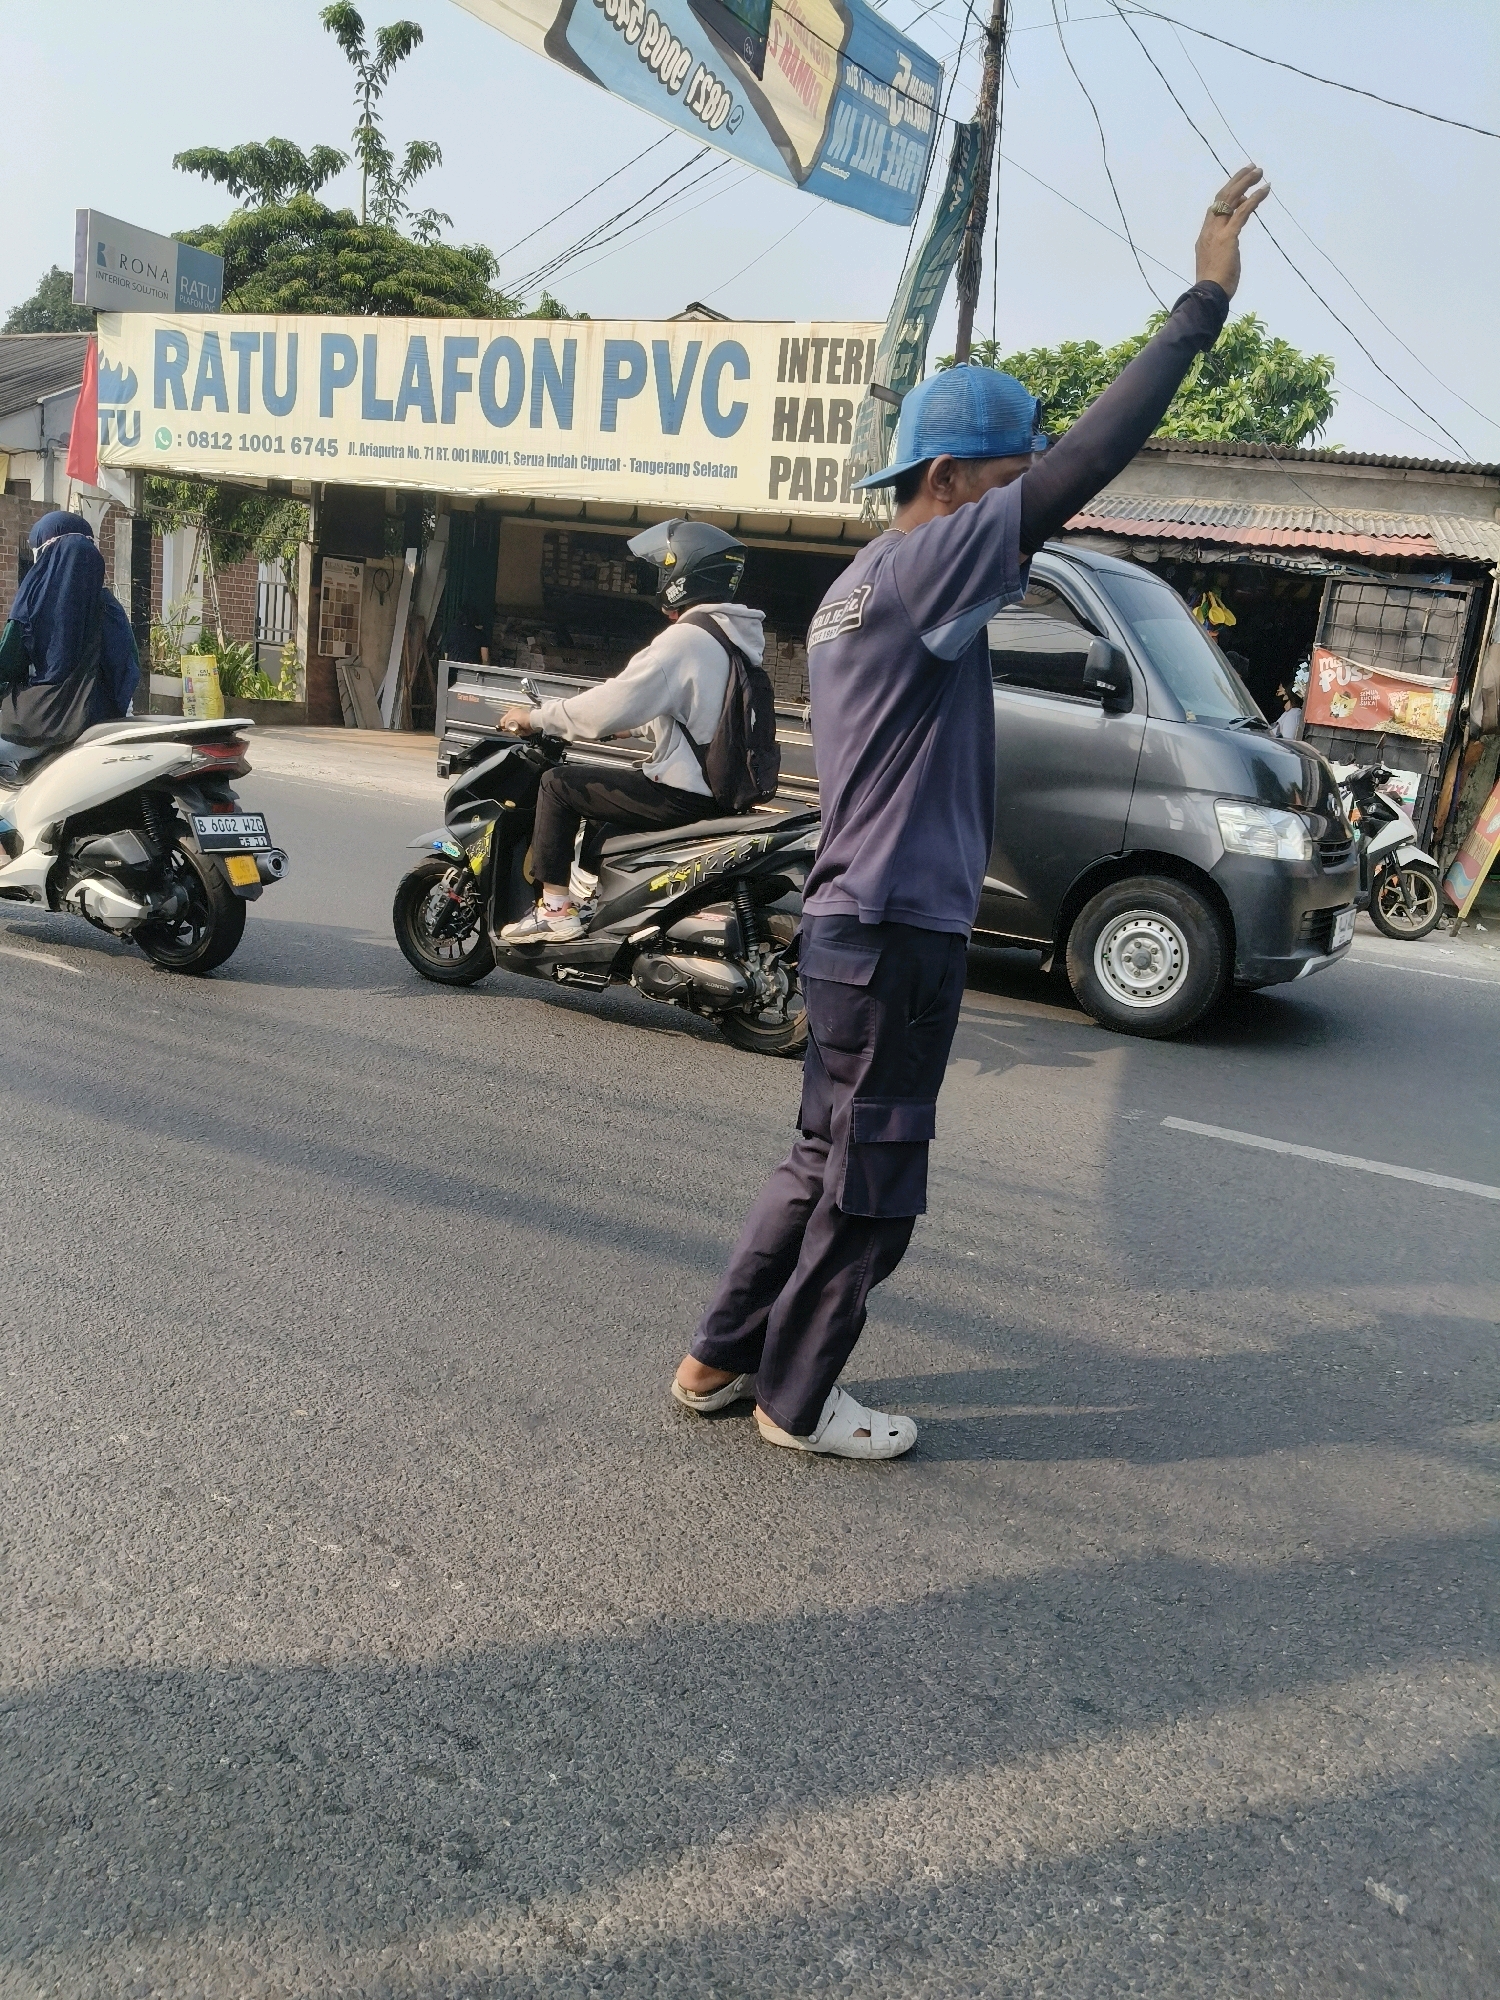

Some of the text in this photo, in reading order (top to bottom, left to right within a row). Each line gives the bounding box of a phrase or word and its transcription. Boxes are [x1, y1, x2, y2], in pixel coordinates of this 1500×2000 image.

[119, 253, 170, 284] RONA
[96, 271, 169, 301] INTERIOR SOLUTION
[180, 276, 217, 304] RATU
[179, 294, 216, 313] PLAFON PVC
[153, 329, 299, 417] RATU
[319, 333, 577, 430] PLAFON
[600, 340, 750, 439] PVC
[771, 396, 863, 445] HAR
[187, 430, 233, 450] 0812
[238, 433, 286, 454] 1001
[290, 436, 339, 458] 6745
[359, 442, 405, 459] Ariaputra
[407, 445, 422, 460] No.
[423, 446, 434, 460] 71
[436, 447, 450, 462] RT.
[451, 448, 470, 463] 001
[513, 451, 544, 467] Serua
[546, 453, 578, 469] Indah
[580, 454, 621, 472] Ciputat
[629, 457, 691, 478] Tangerang
[692, 460, 738, 479] Selatan
[197, 817, 264, 833] B 6002 WZG
